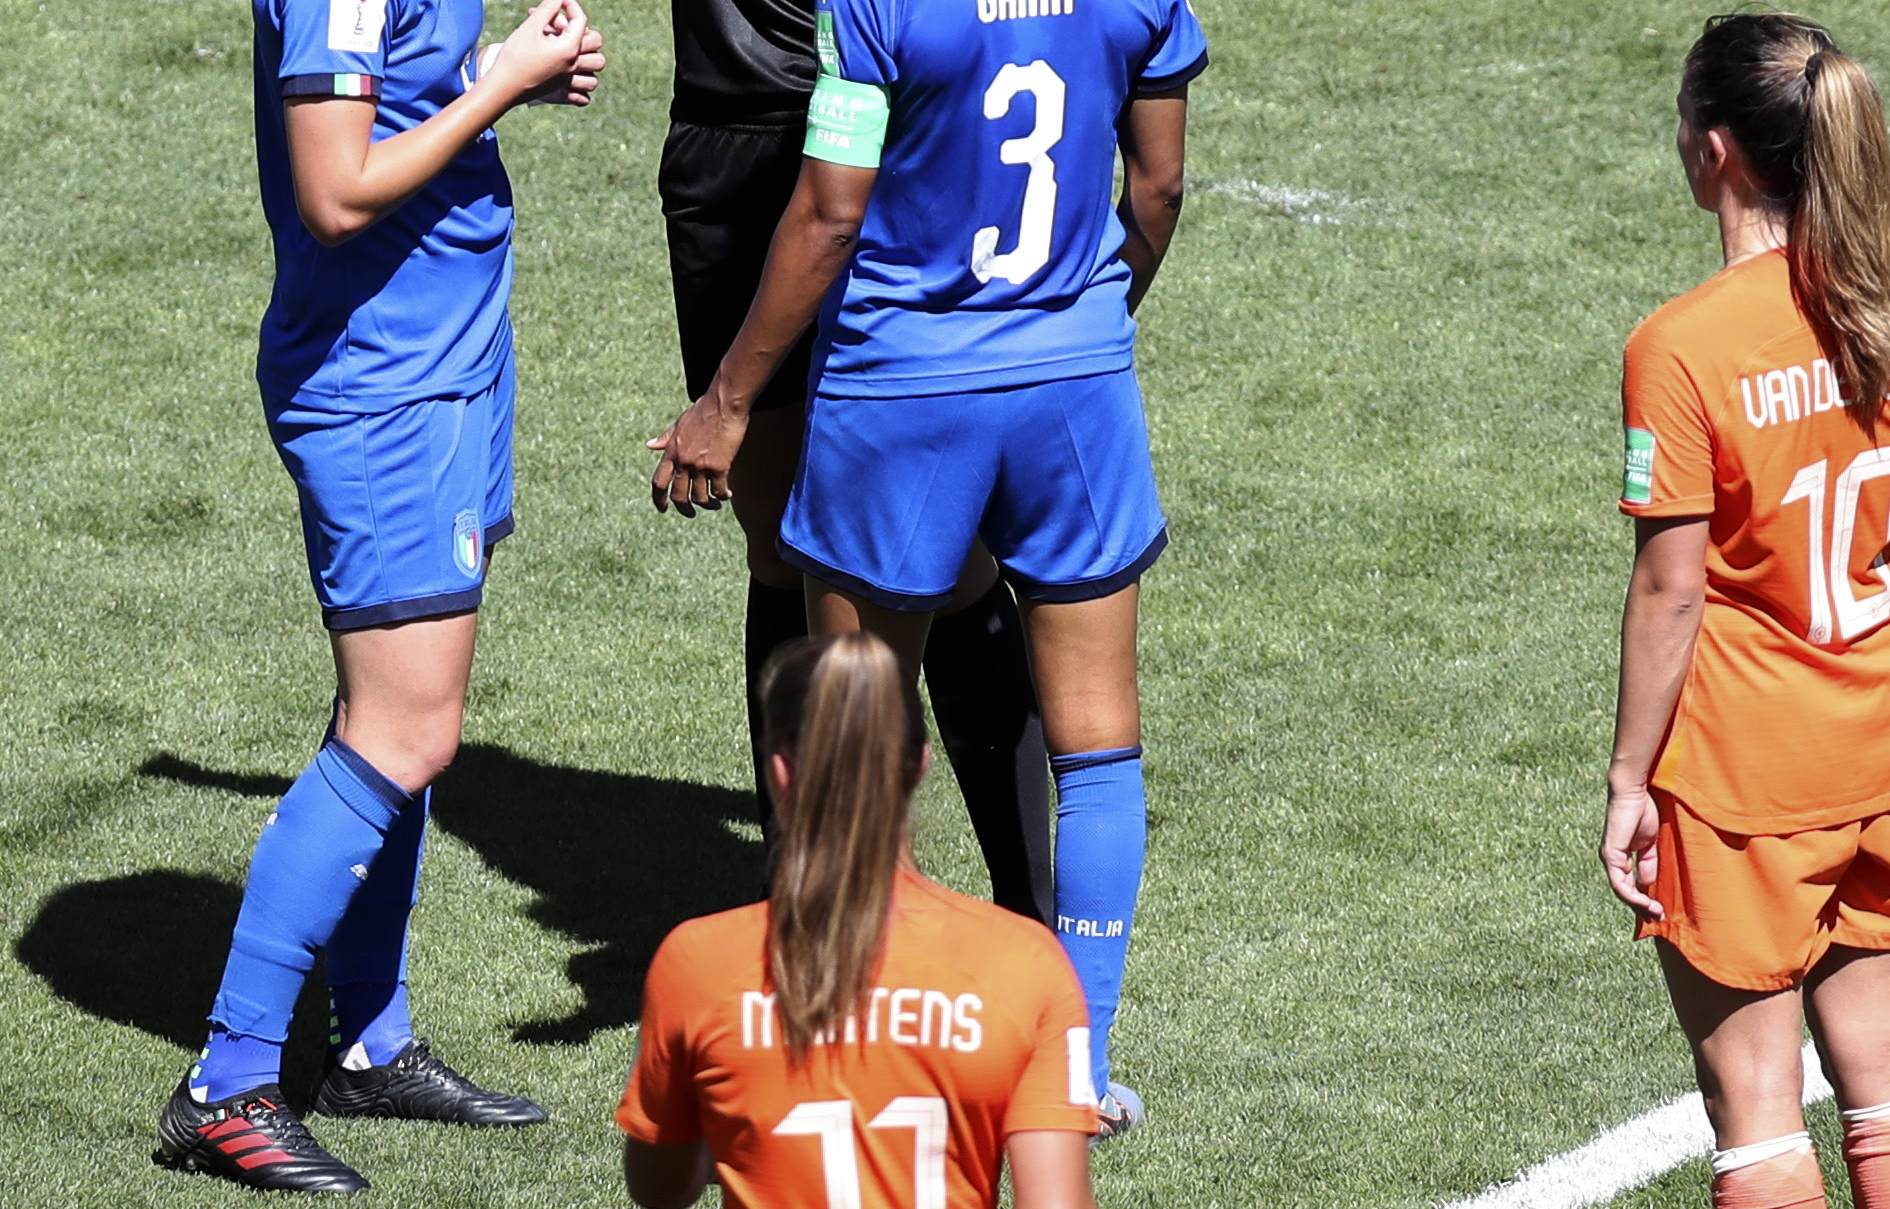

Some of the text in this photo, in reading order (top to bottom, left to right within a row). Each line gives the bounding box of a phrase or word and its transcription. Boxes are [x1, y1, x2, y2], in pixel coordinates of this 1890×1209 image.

[816, 128, 850, 149] FIFA
[970, 58, 1067, 286] 3
[1057, 914, 1124, 938] ITALIA
[741, 987, 983, 1053] MTENS
[771, 1095, 949, 1209] 11
